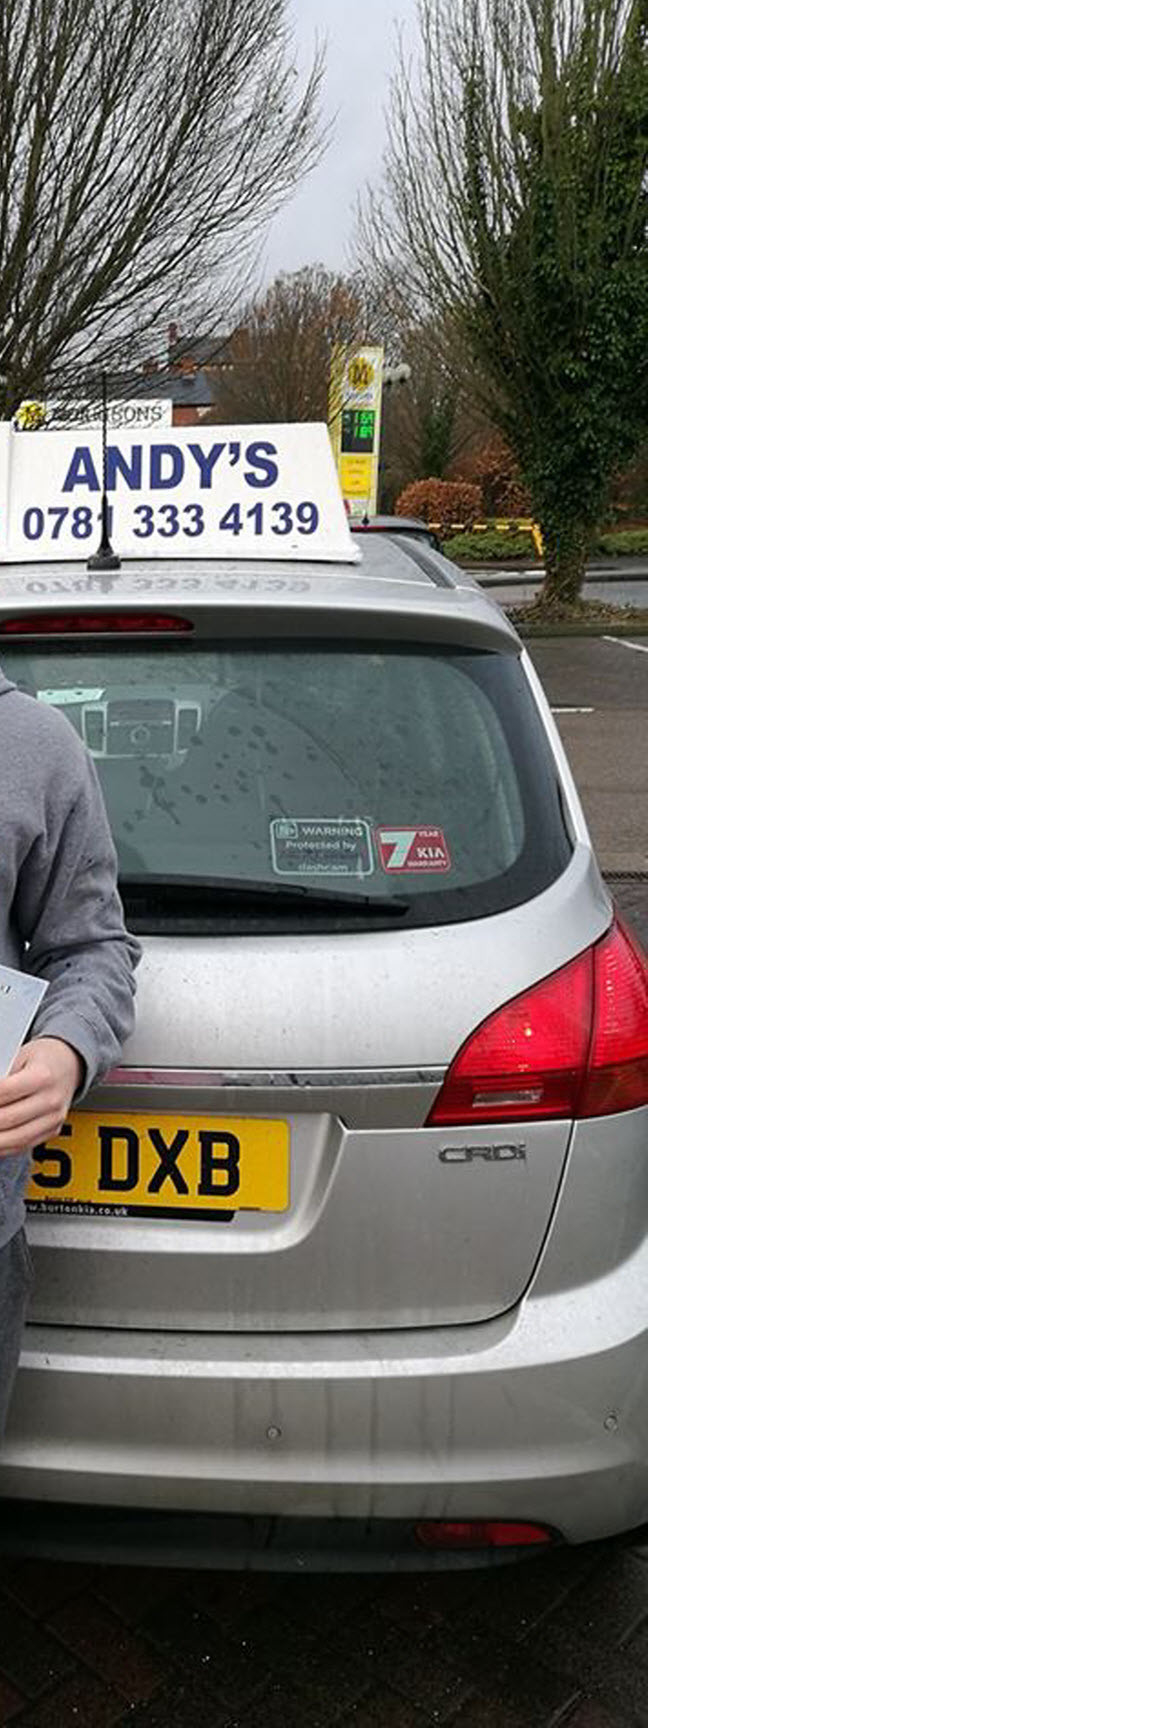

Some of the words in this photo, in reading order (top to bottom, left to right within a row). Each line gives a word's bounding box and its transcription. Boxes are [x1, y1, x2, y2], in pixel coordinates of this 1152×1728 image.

[61, 441, 278, 493] ANDY'S
[133, 503, 205, 538] 333
[219, 501, 319, 536] 4139
[285, 840, 340, 850] Protected
[343, 840, 357, 852] by
[302, 826, 363, 837] WARNING
[380, 831, 416, 868] 7
[416, 847, 445, 858] KIA
[98, 1126, 240, 1197] DXB
